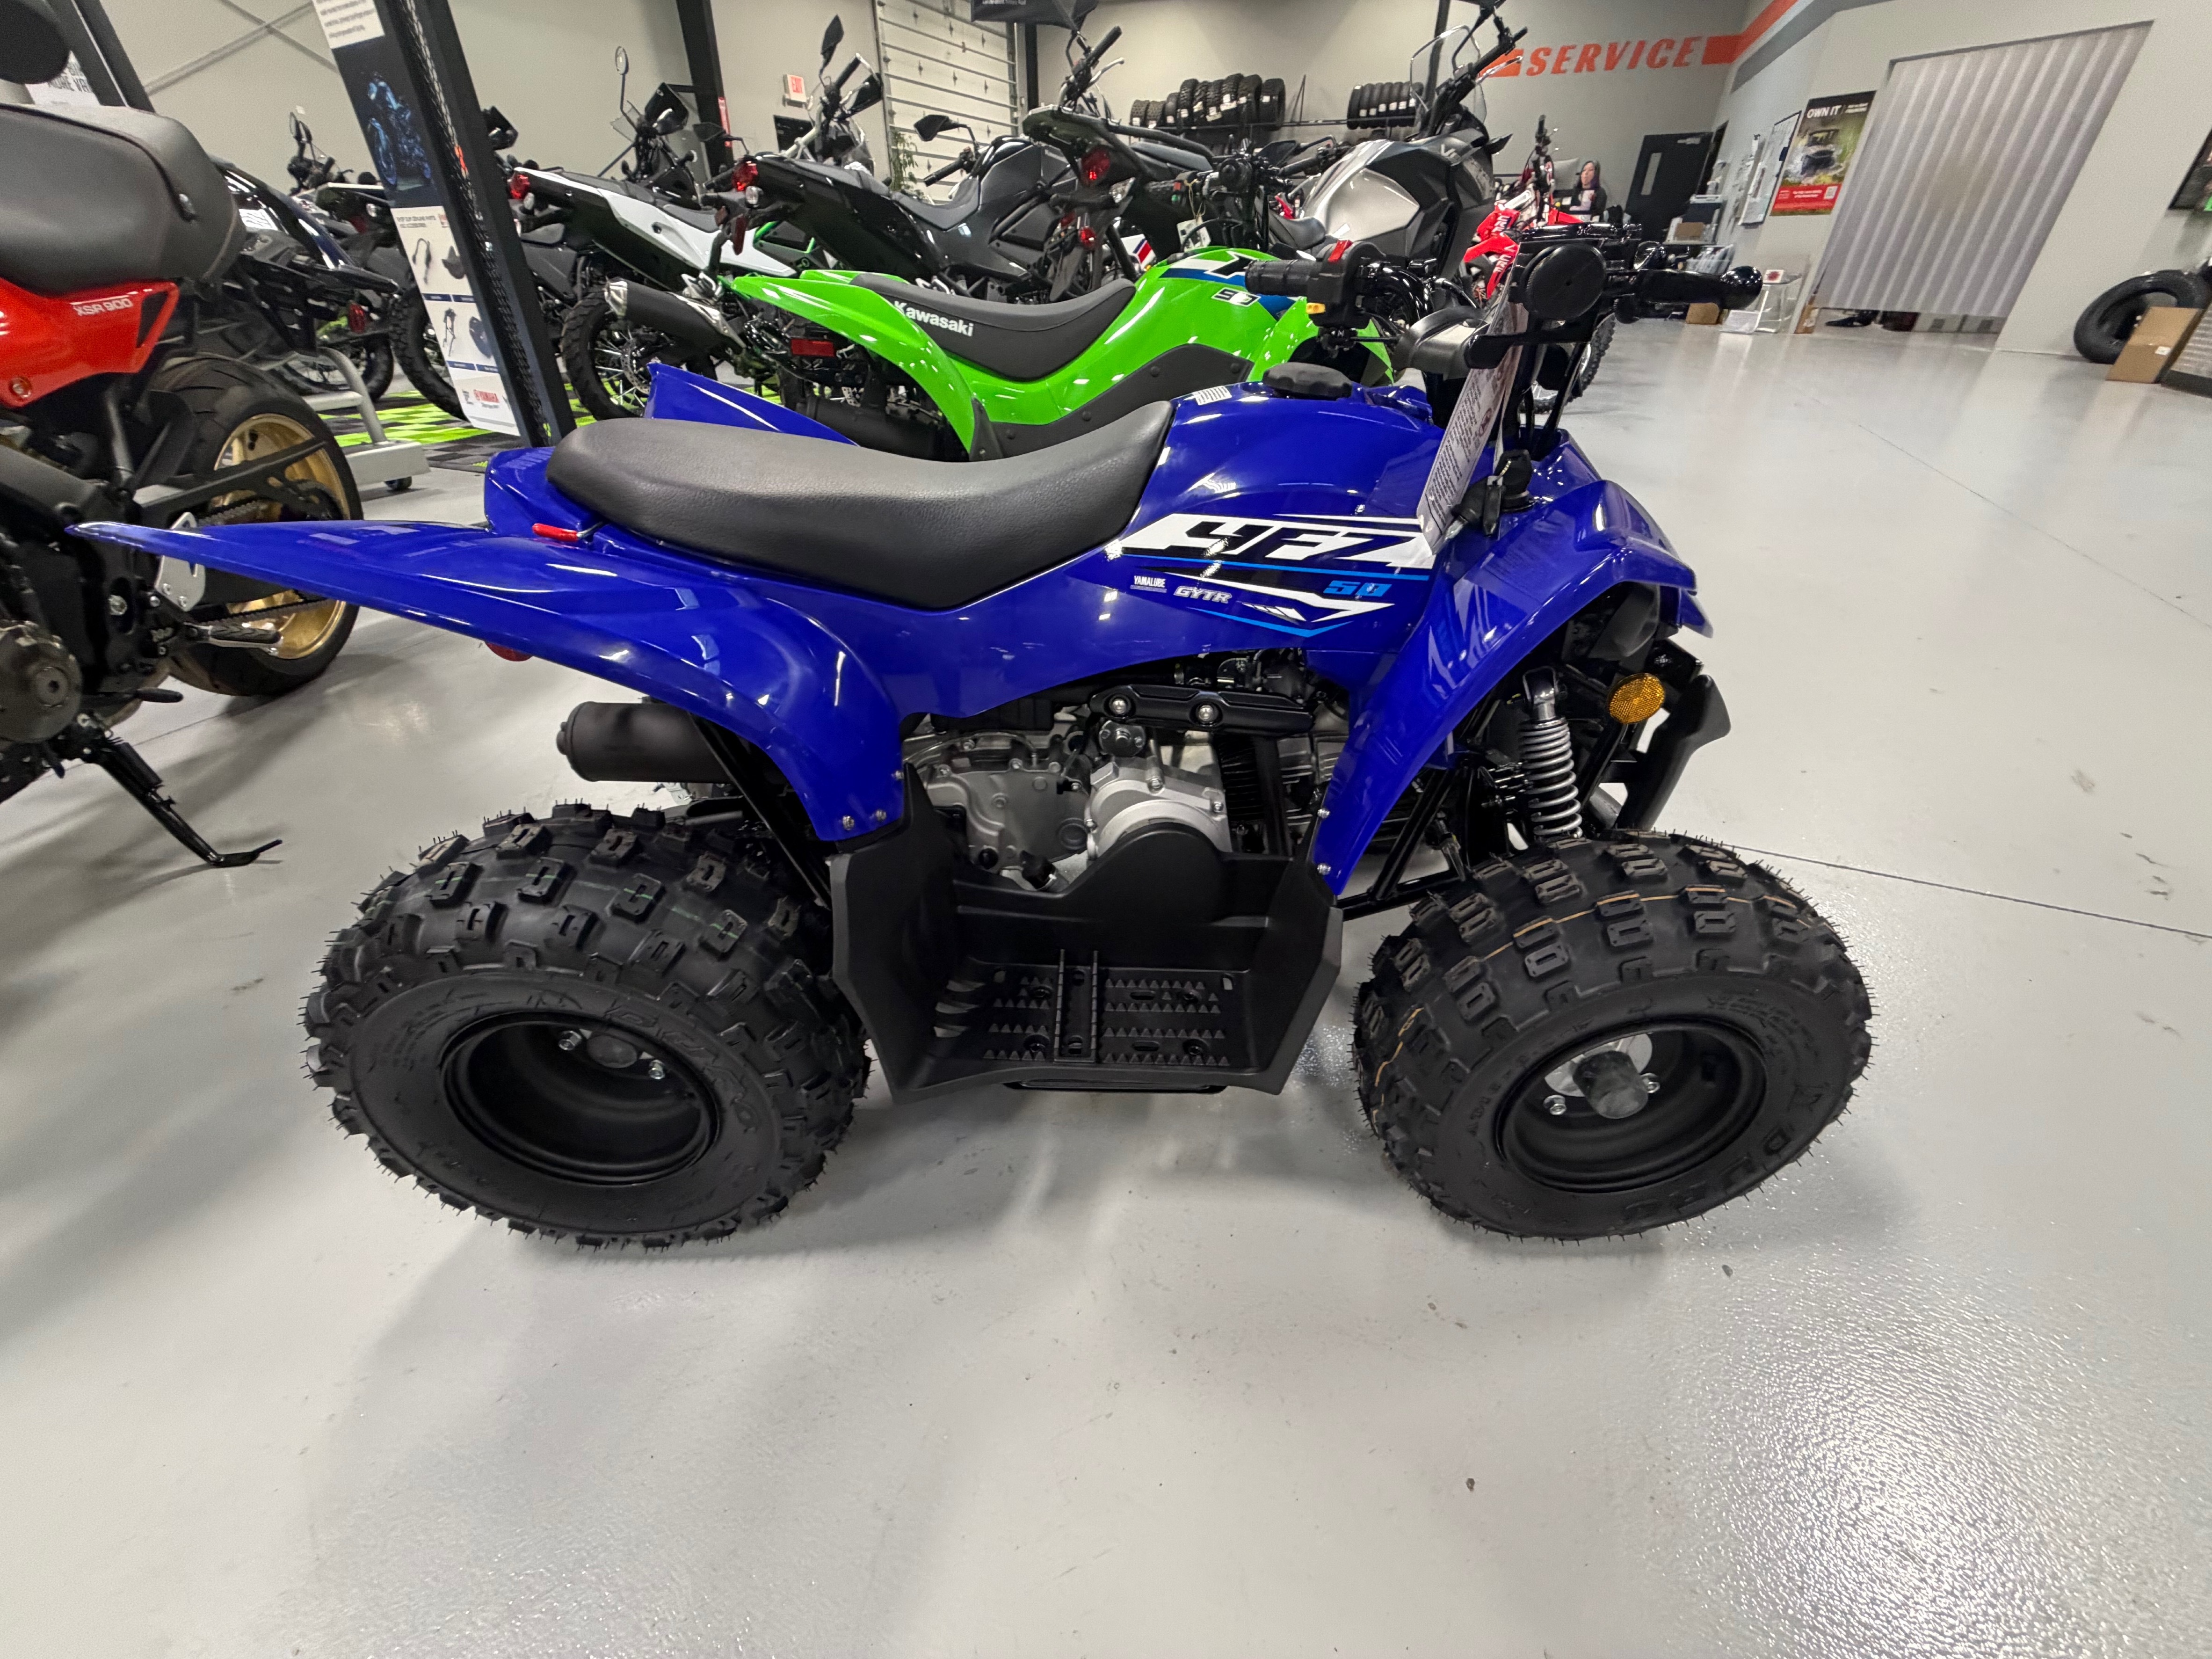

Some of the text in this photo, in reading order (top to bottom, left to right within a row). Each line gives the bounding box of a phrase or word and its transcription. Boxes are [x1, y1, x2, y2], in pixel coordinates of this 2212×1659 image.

[1526, 36, 1703, 76] SERVICE
[1806, 107, 1829, 118] OWN
[1829, 105, 1842, 116] IT
[73, 298, 134, 317] XSR 900
[894, 300, 974, 337] Kawasaki
[1185, 521, 1416, 567] YFZ
[1133, 575, 1167, 588] YAMALUBE
[1323, 580, 1392, 597] 50
[1174, 585, 1233, 604] GYTR
